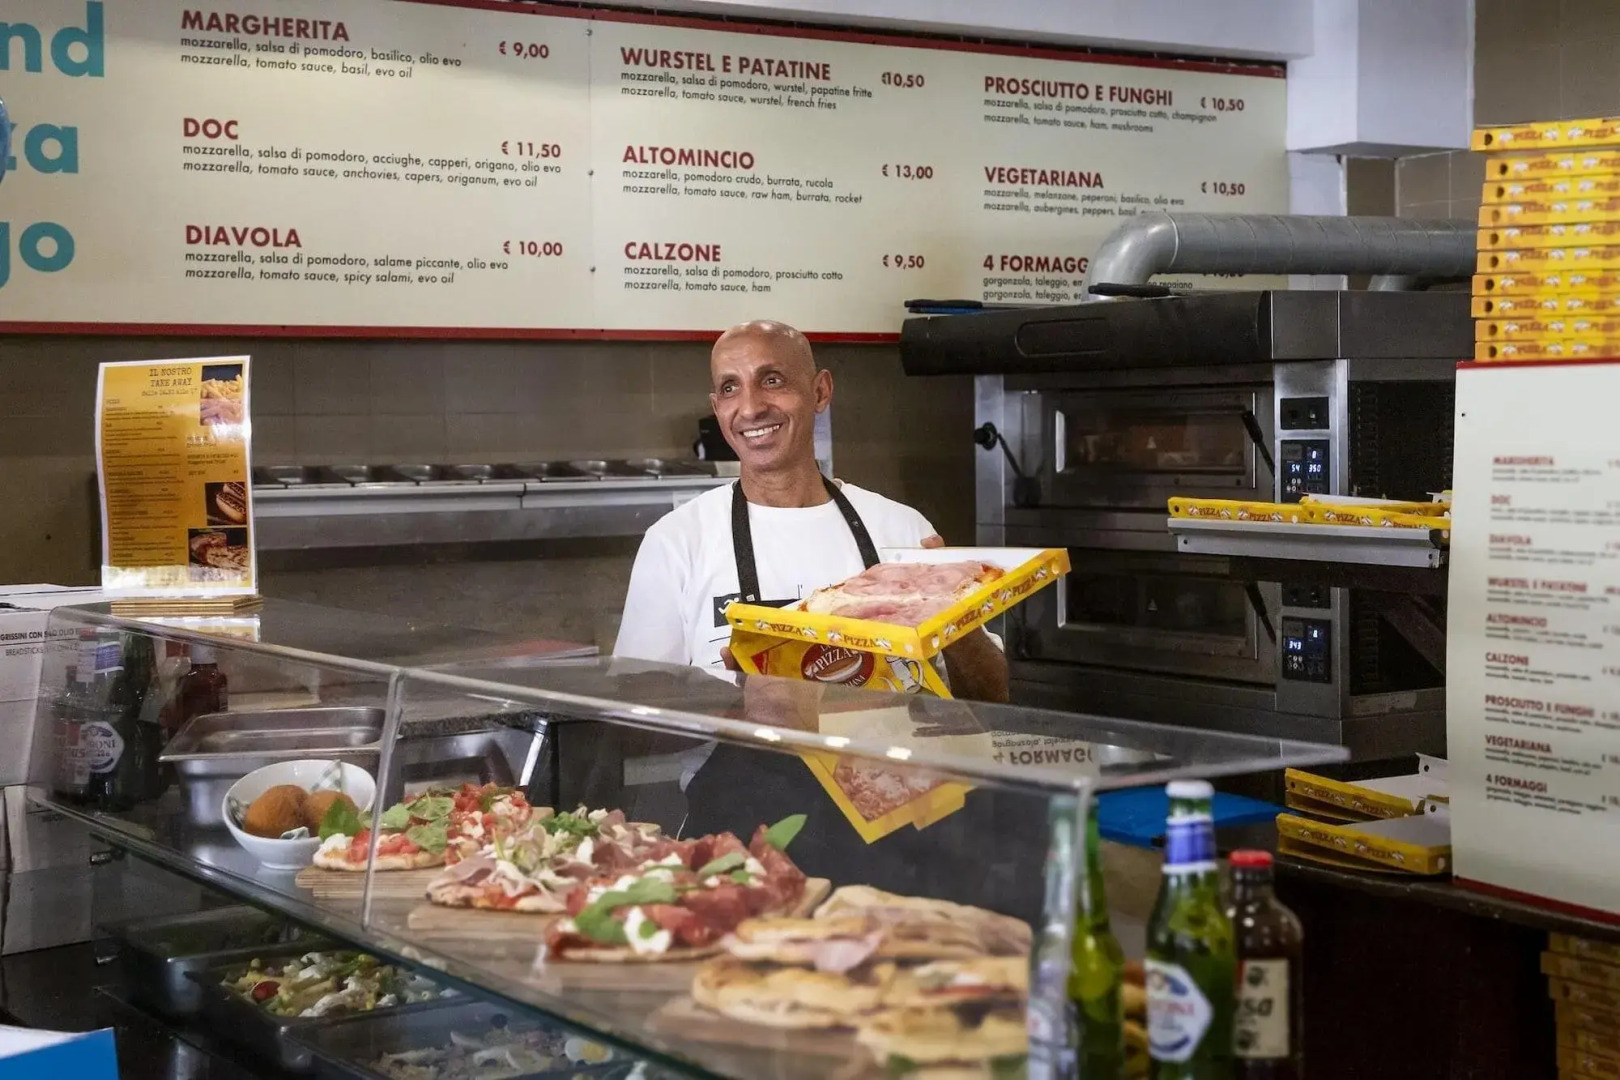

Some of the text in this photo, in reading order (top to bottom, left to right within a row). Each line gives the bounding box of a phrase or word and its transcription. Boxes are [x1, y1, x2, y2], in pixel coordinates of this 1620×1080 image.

[181, 9, 350, 42] MARGHERITA
[180, 37, 462, 66] mozzarella, salsa di pomodoro, basilico, olio evo
[498, 40, 549, 59] € 9,00
[180, 54, 412, 78] mozzarella, tomato sauce, basil, evo oil
[620, 46, 830, 81] WURSTEL E PATATINE
[681, 74, 706, 85] salsa
[707, 76, 717, 86] di
[810, 85, 850, 97] papatine
[852, 85, 872, 98] fritte
[984, 75, 1172, 106] PROSCIUTTO E FUNGHI
[681, 88, 715, 100] tomato
[786, 96, 815, 108] french
[817, 98, 836, 109] fries
[1200, 96, 1244, 111] € 10,50
[183, 117, 238, 140] DOC
[182, 145, 561, 173] mozzarella, salsa di pomodoro, acciughe, capperi, origano, olio evo
[501, 140, 561, 159] € 11,50
[622, 144, 754, 170] ALTOMINCIO
[182, 161, 537, 187] mozzarella, tomato sauce, anchovies, capers, origanum, evo oil
[622, 169, 833, 188] mozzarella, pomodoro crudo, burrata, rucola
[881, 163, 933, 180] € 13,00
[984, 165, 1104, 188] VEGETARIANA
[622, 184, 862, 203] mozzarella, tomato sauce, raw ham, burrata, rocket
[1200, 180, 1245, 196] € 10,50
[185, 224, 302, 248] DIAVOLA
[502, 239, 563, 257] € 10,00
[624, 241, 720, 262] CALZONE
[184, 251, 508, 270] mozzarella, salsa di pomodoro, salame piccante, olio evo
[882, 253, 925, 269] € 9,50
[982, 253, 1089, 274] 4 FORMAGG
[185, 267, 454, 285] mozzarella, tomato sauce, spicy salami, evo oil
[623, 265, 843, 281] mozzarella, salsa di pomodoro, prosciutto cotto
[624, 280, 771, 292] mozzarella, tomato sauce, ham
[1308, 464, 1322, 473] 350
[1198, 507, 1221, 517] PIZZA
[1250, 512, 1272, 522] PIZZA
[1336, 514, 1361, 524] PIZZA
[1012, 575, 1038, 597] PIZZA
[955, 608, 984, 630] PIZZA
[0, 632, 27, 641] GRISSINI
[29, 631, 42, 639] CON
[770, 623, 804, 637] PIZZA
[843, 634, 877, 648] PIZZA
[815, 648, 852, 670] PIZZA
[1486, 652, 1529, 666] CALZONE
[1485, 694, 1544, 712] PROSCIUTTO
[1485, 734, 1552, 754] VEGETARIANA
[1495, 776, 1548, 794] FORMAGGI
